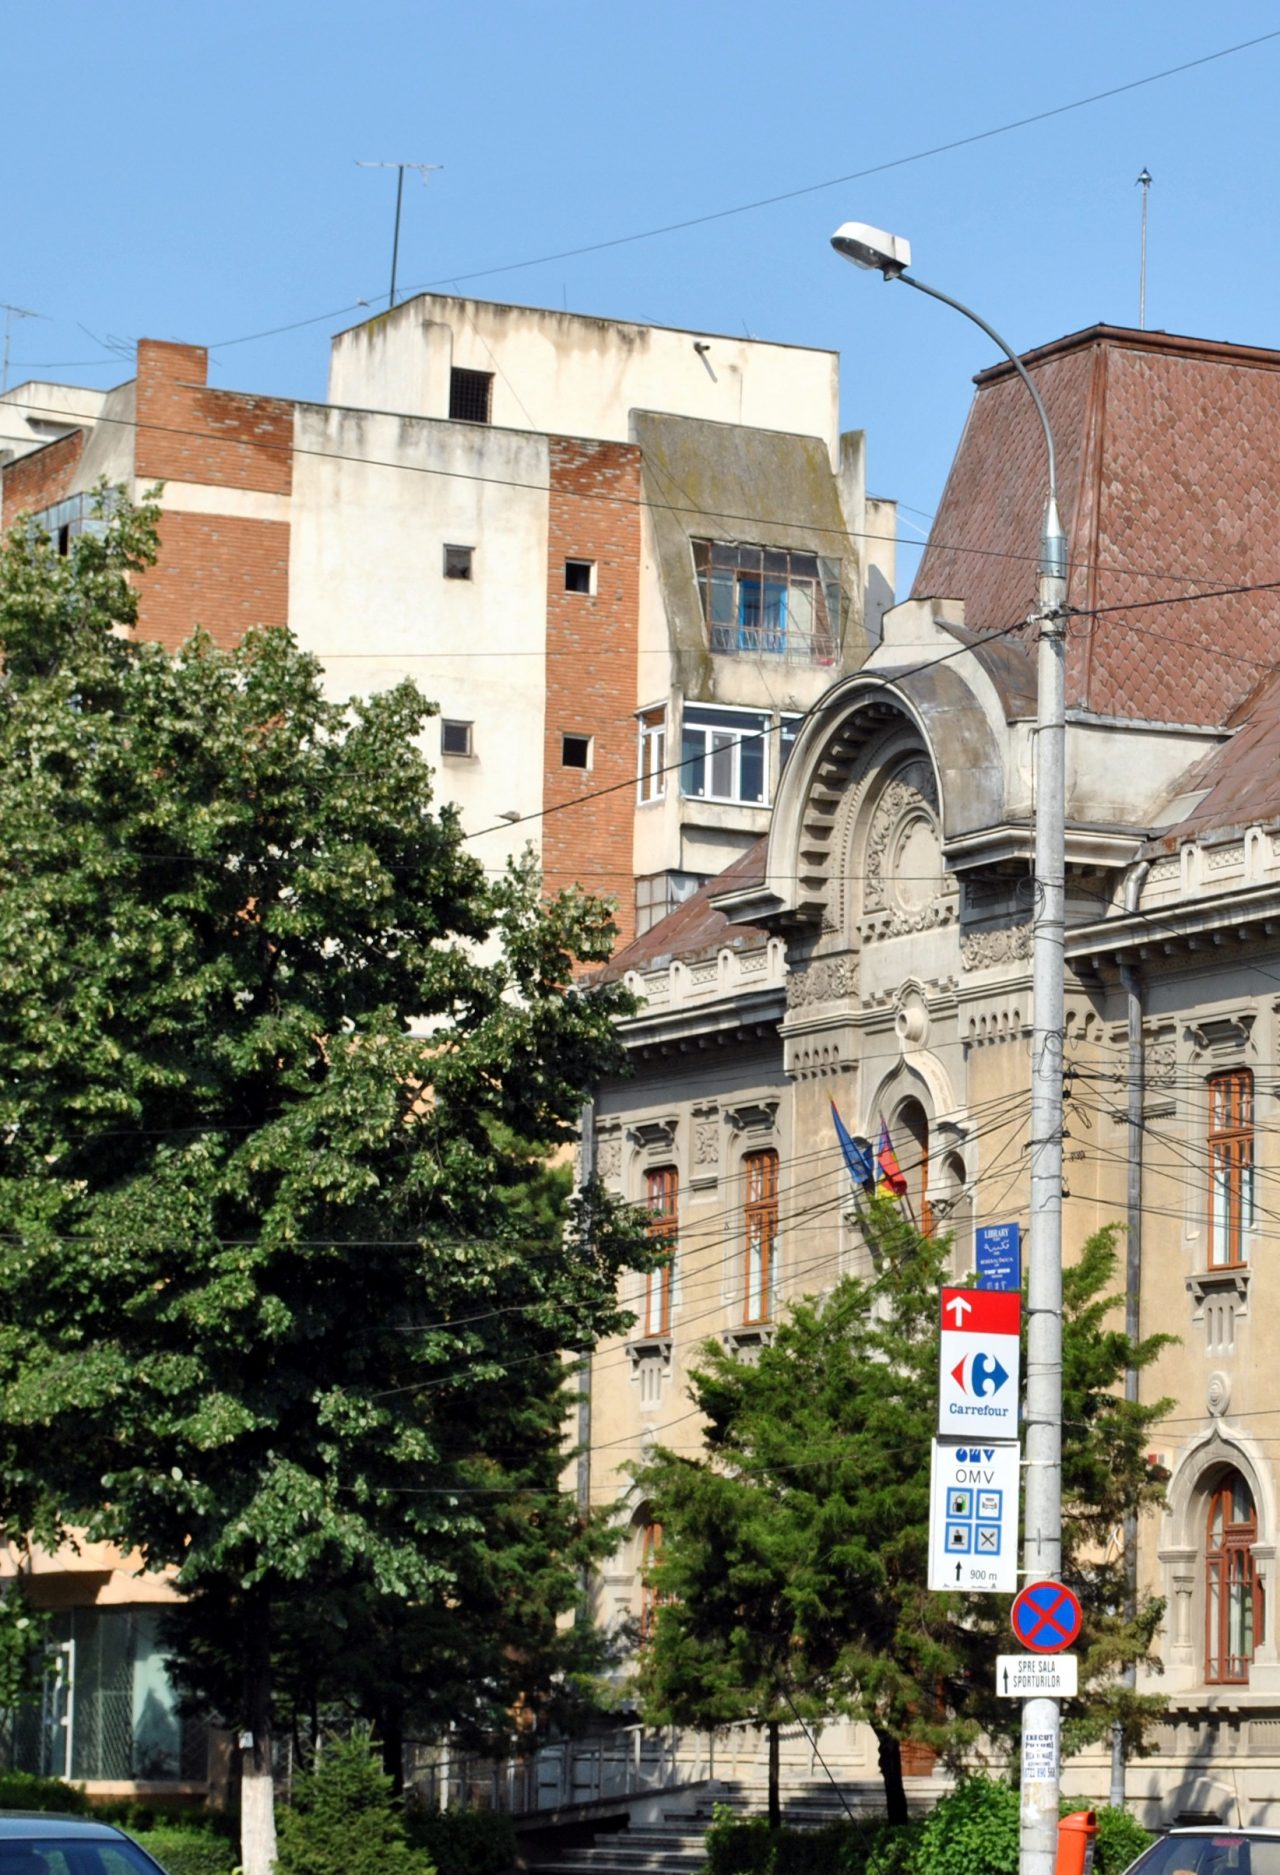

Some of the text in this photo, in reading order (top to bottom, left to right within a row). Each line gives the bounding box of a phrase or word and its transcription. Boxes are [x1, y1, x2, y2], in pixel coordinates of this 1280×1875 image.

[984, 1228, 1009, 1239] LIBRARY
[949, 1403, 1009, 1417] Carrefour
[955, 1447, 996, 1463] OMV
[955, 1469, 995, 1485] OMV
[970, 1569, 998, 1581] 900 m
[1018, 1660, 1056, 1673] SPRE SALA
[1013, 1675, 1061, 1688] SPORTURILOR
